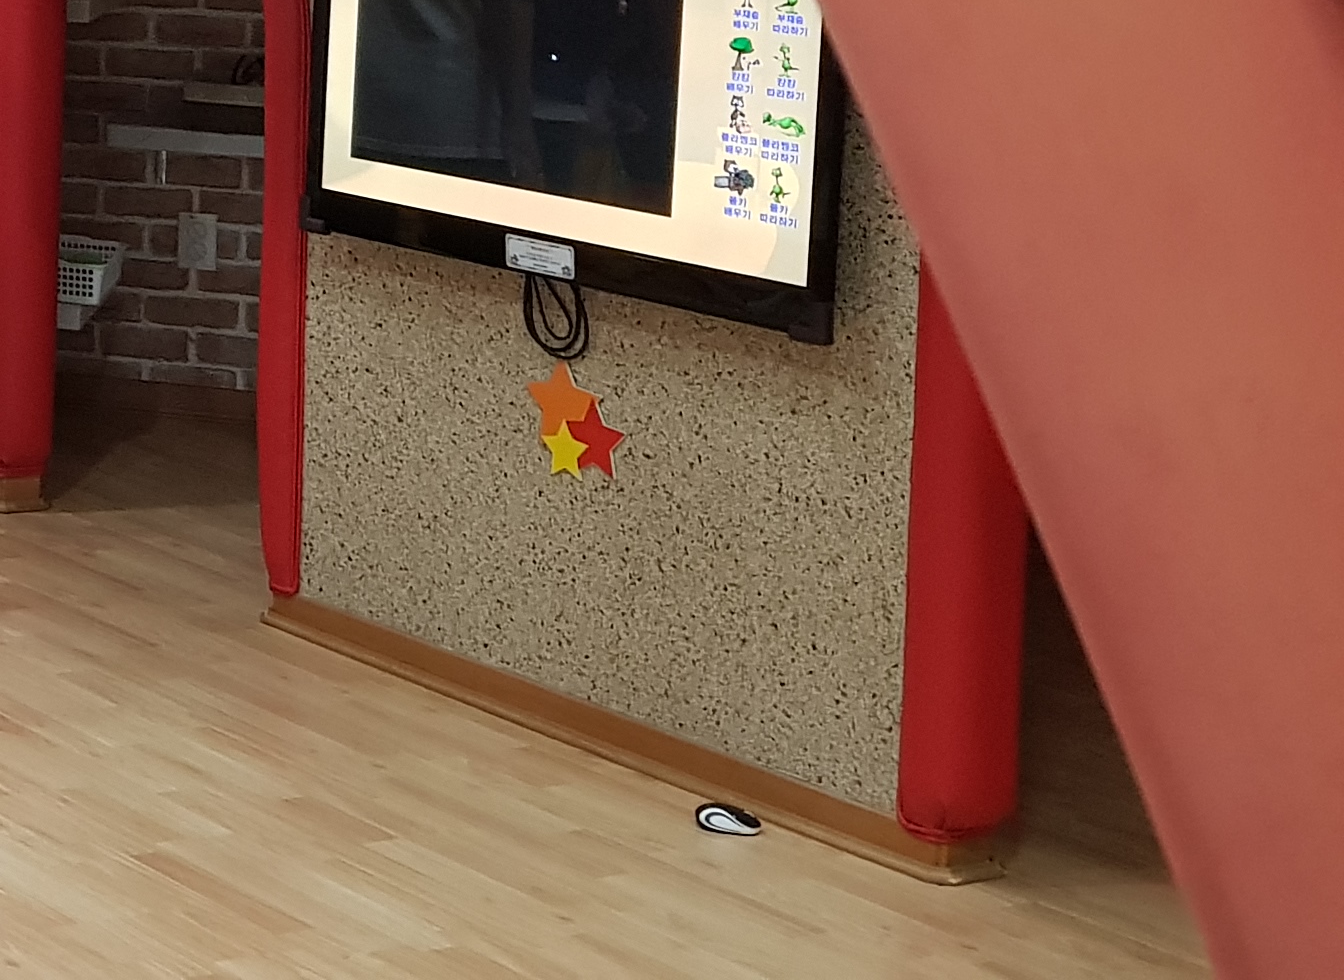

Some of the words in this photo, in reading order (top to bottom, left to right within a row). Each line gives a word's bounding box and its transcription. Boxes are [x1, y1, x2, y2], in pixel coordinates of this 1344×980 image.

[733, 20, 759, 31] 배우기
[772, 24, 808, 37] 따라하기
[726, 83, 754, 95] 배우기
[766, 88, 805, 101] 따라하기
[725, 145, 753, 158] 배우기
[761, 150, 799, 164] 따라하기
[724, 207, 751, 220] 배우기
[760, 213, 798, 229] 따라하기
